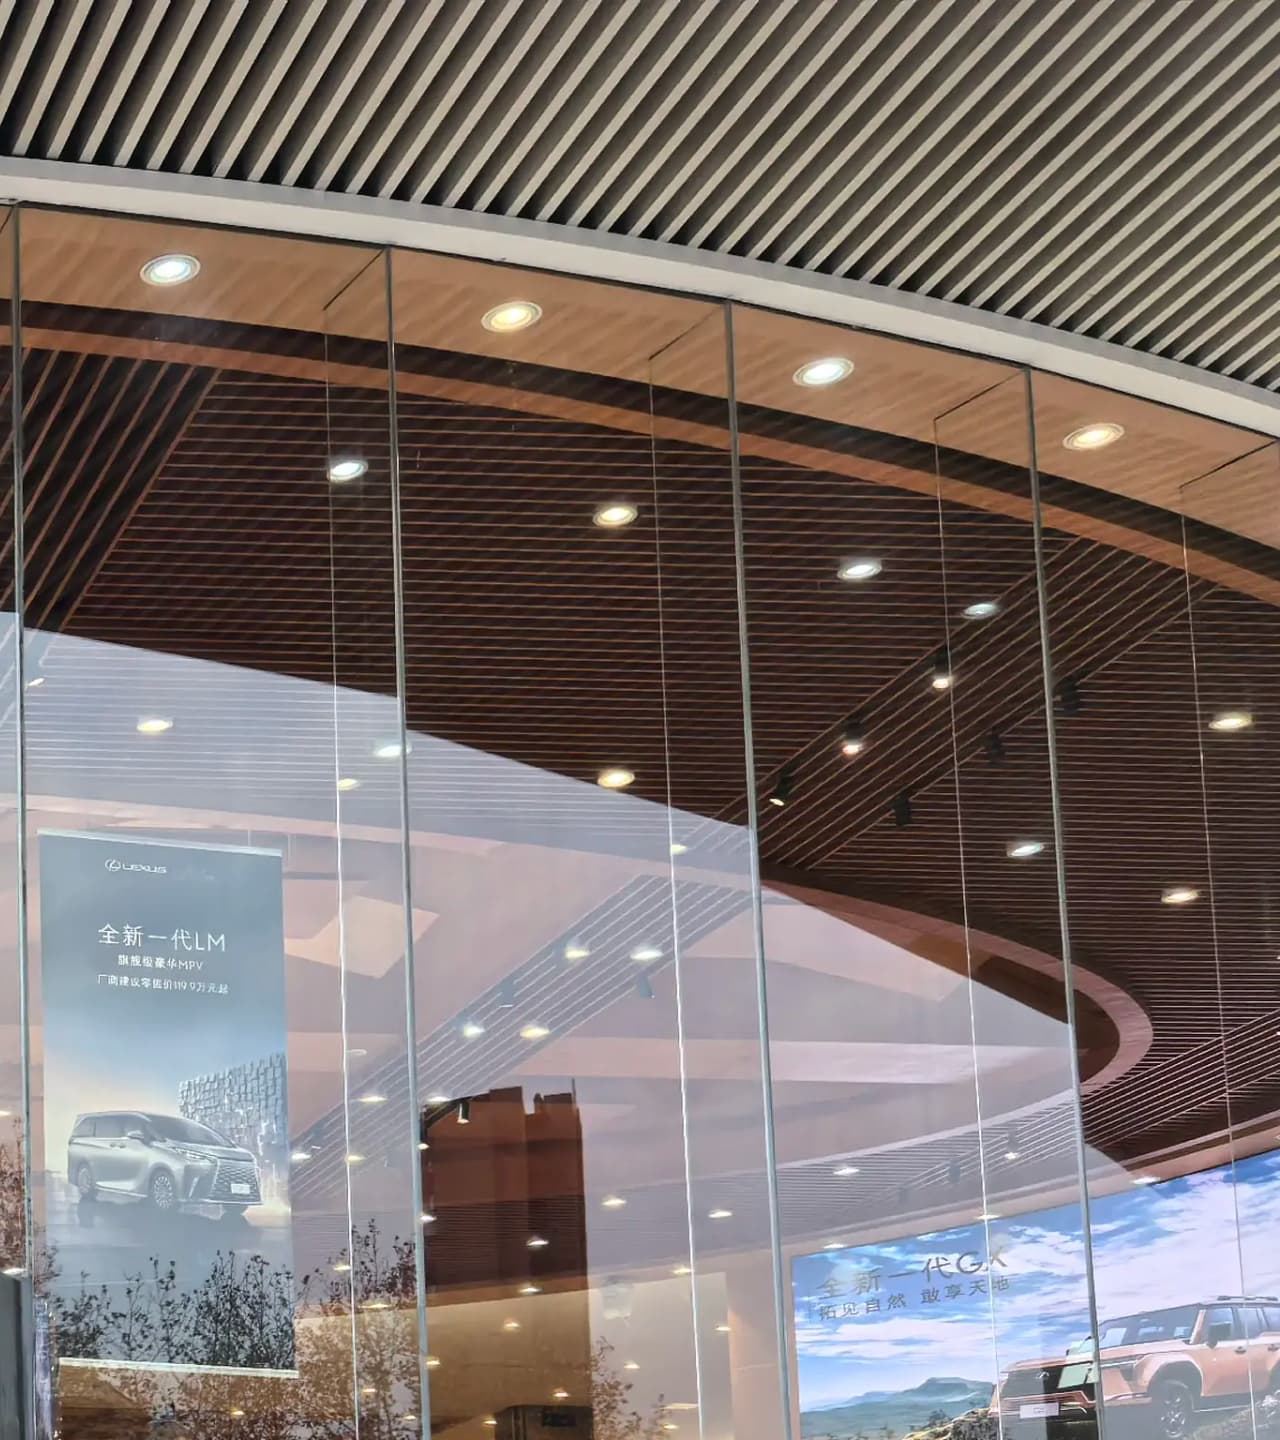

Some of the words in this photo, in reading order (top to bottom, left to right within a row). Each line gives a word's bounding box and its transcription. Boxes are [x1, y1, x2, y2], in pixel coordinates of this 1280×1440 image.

[122, 863, 167, 874] LEXUS
[97, 923, 226, 952] 全新一代LM
